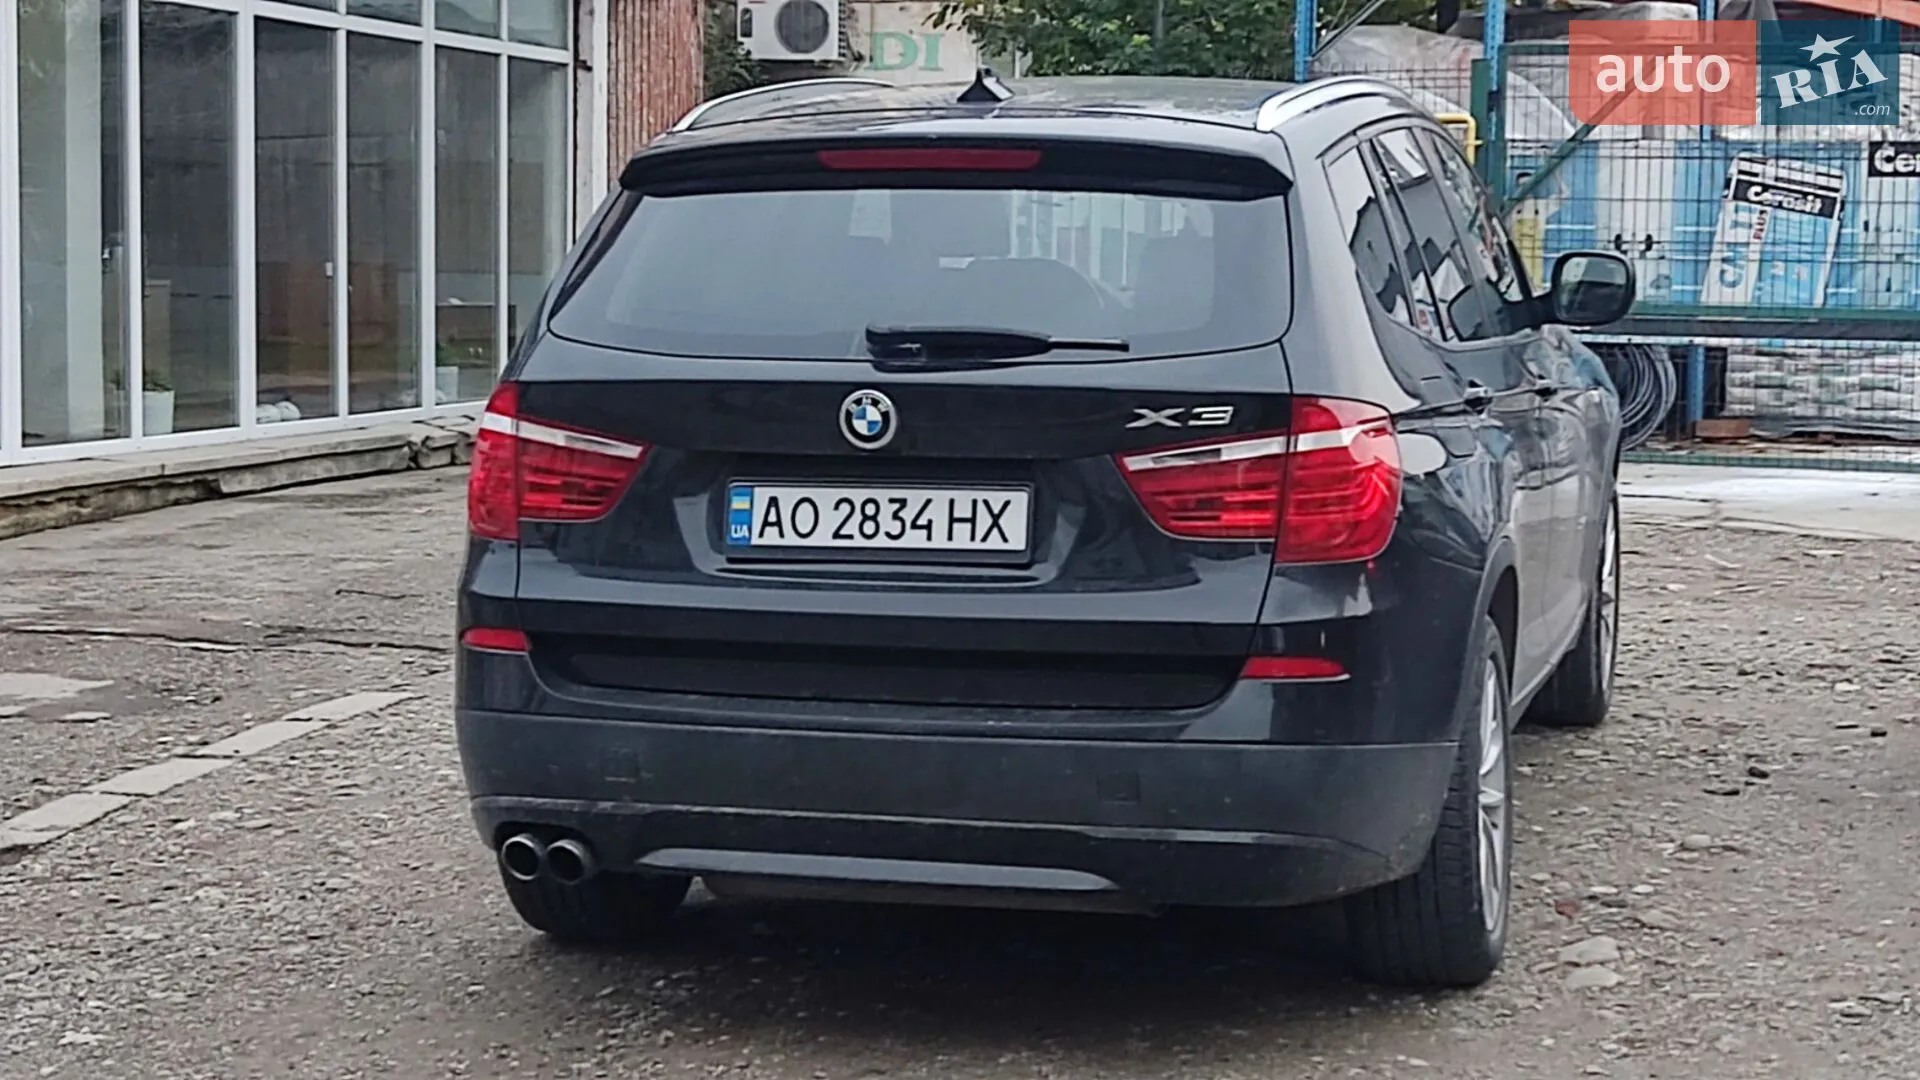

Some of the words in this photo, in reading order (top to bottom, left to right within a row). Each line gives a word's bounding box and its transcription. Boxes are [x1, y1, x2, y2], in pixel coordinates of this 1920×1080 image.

[864, 31, 945, 71] DI
[1124, 406, 1234, 428] X3
[730, 524, 750, 539] UA
[758, 496, 820, 540] AO
[831, 497, 934, 542] 2834
[946, 498, 1012, 543] HX
